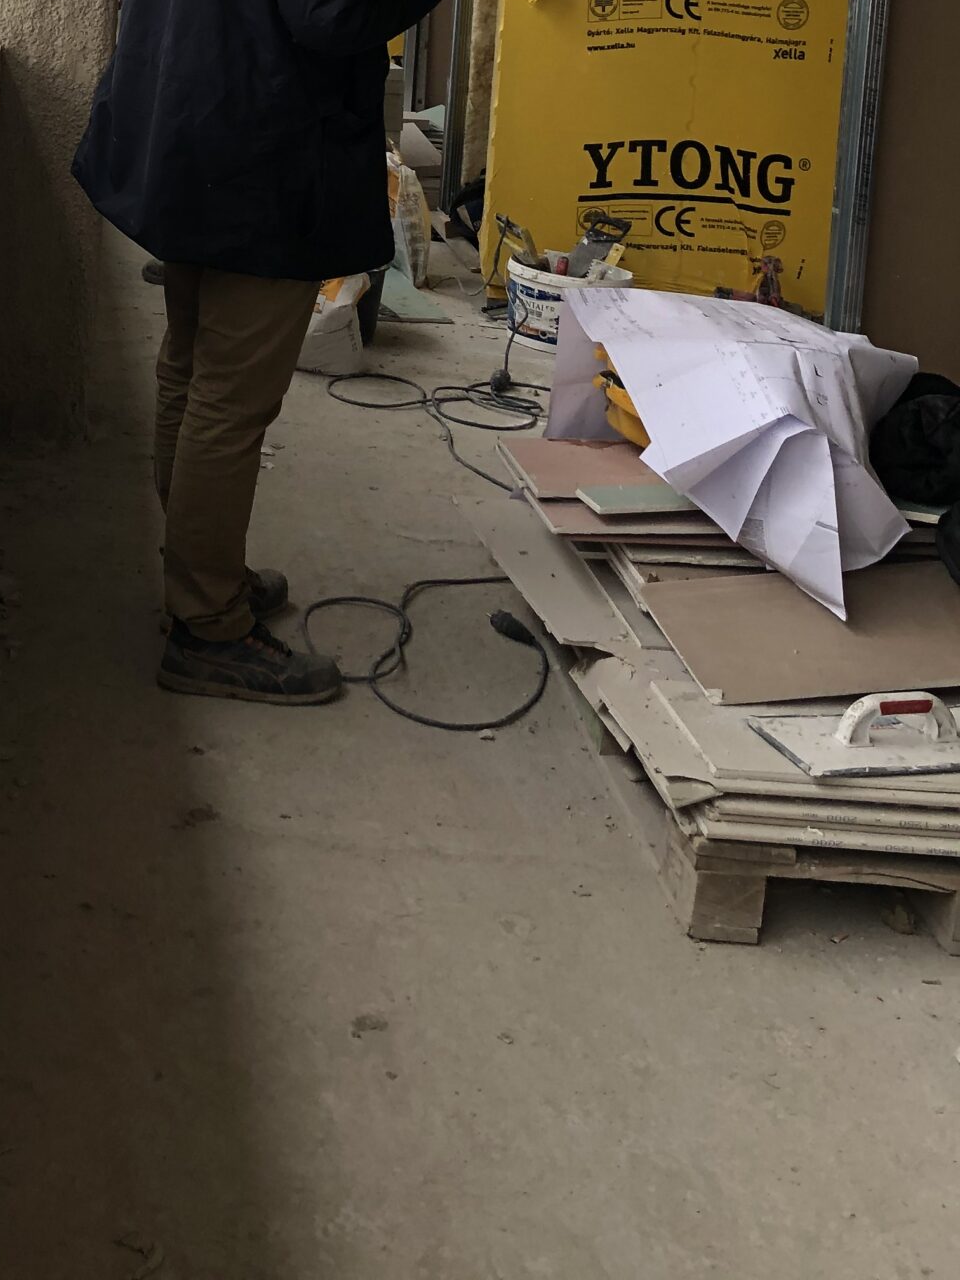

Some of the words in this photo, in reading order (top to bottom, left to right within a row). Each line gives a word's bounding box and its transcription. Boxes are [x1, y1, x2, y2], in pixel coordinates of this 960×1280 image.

[637, 26, 686, 36] Magyarország
[584, 140, 795, 203] YTONG
[655, 206, 696, 238] CE
